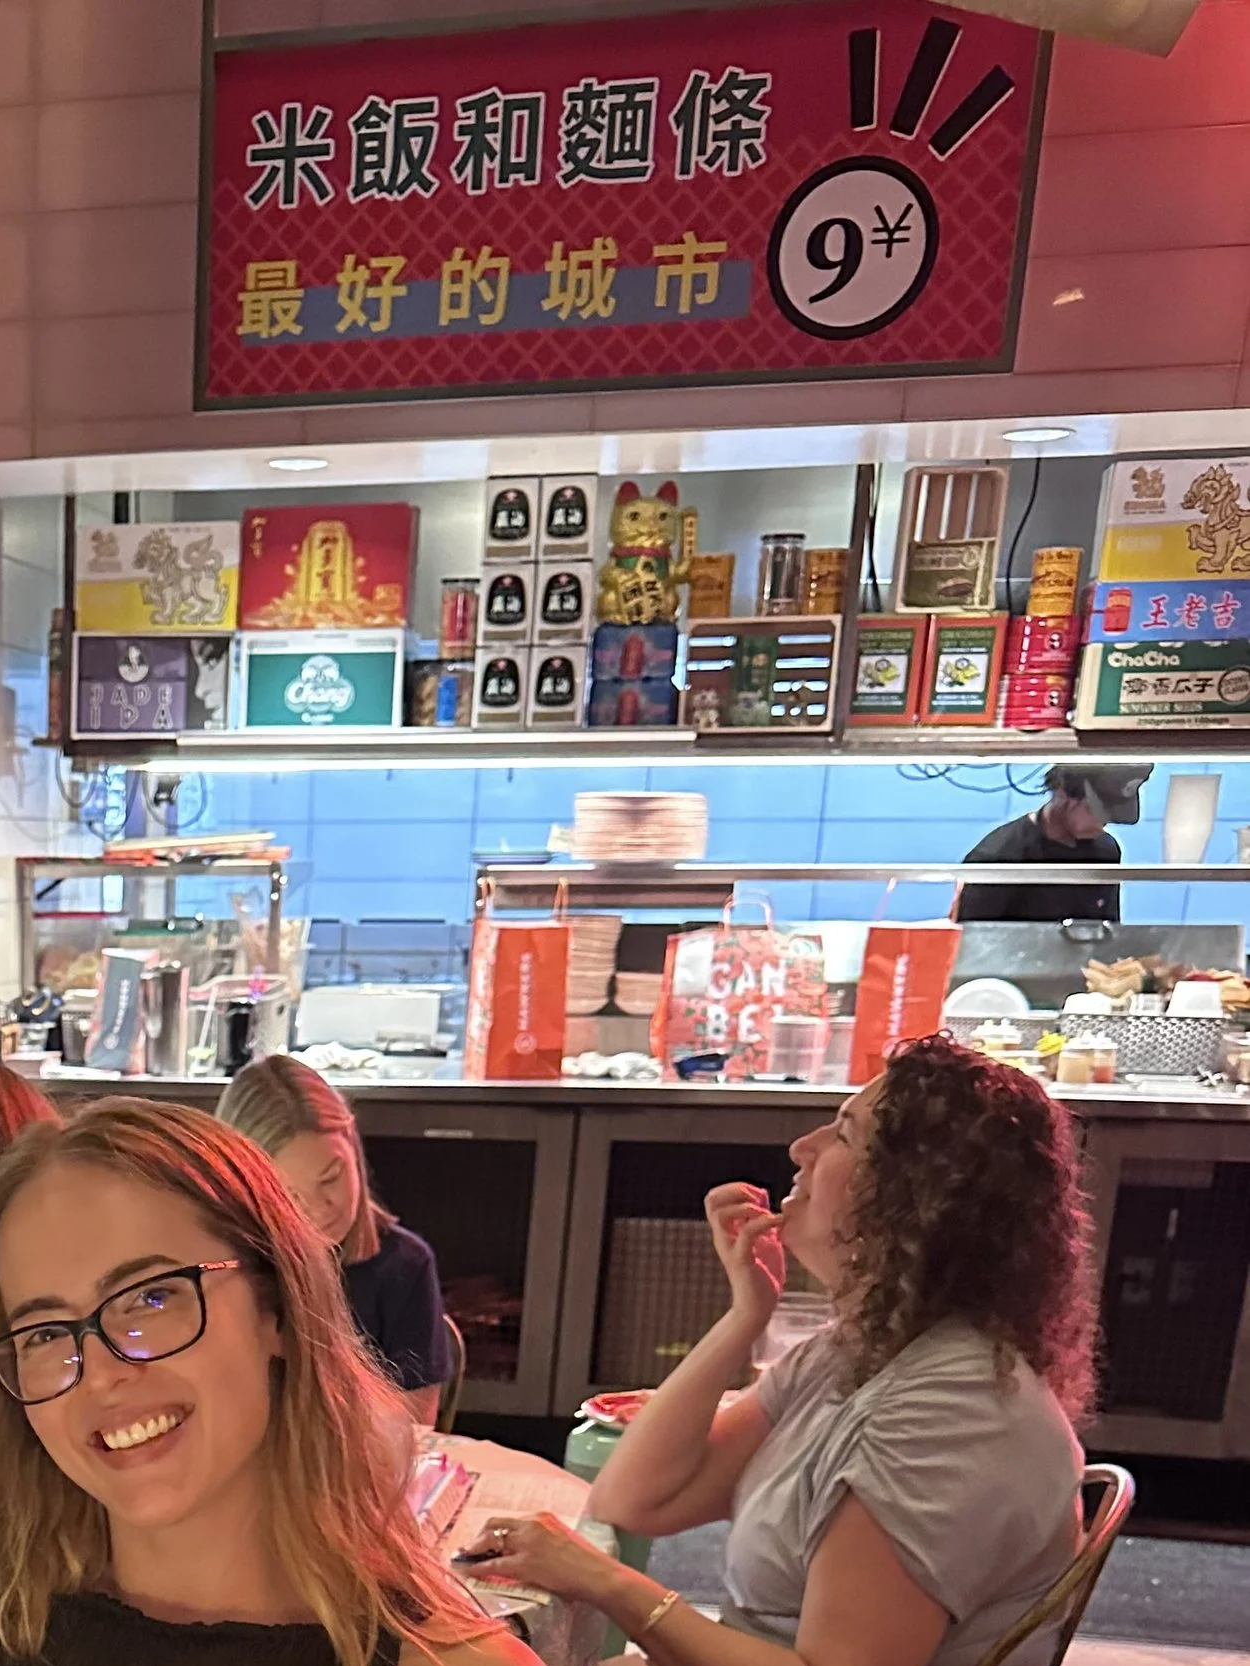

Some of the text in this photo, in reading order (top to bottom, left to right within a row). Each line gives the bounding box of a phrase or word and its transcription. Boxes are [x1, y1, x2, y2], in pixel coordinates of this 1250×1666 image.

[246, 67, 771, 210] 米飯和麵條
[237, 234, 728, 339] 最好的城市
[1141, 591, 1241, 630] 王老吉
[1108, 651, 1180, 668] ChaCha
[89, 684, 173, 706] JADE
[286, 684, 351, 707] Chang
[708, 958, 787, 999] GAN
